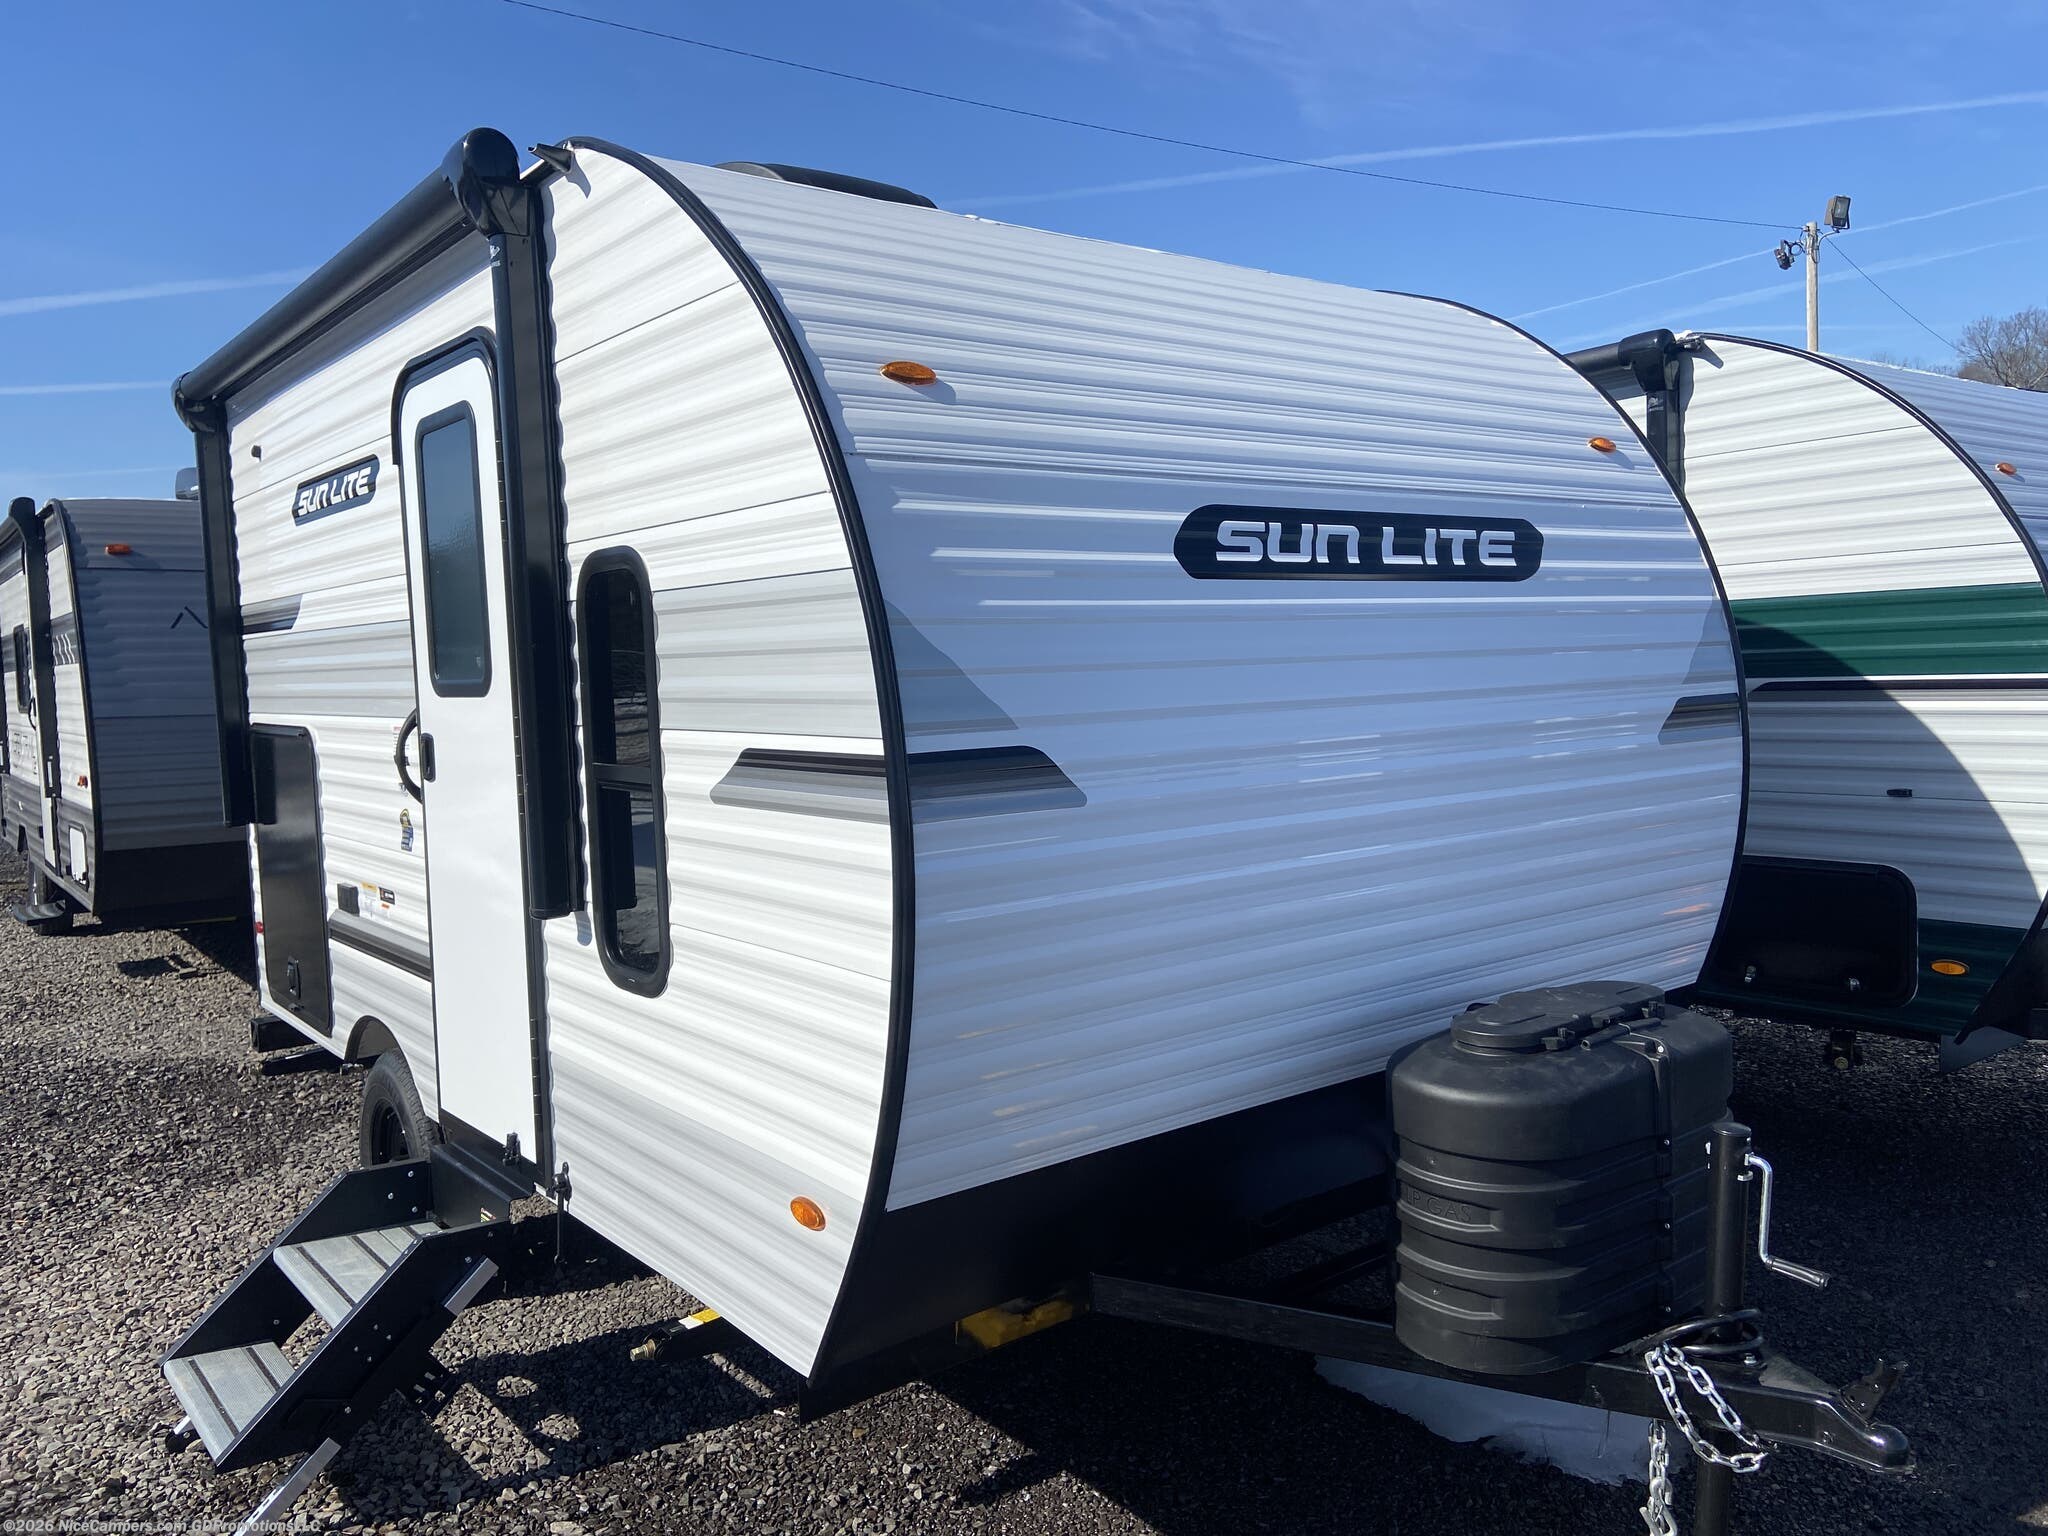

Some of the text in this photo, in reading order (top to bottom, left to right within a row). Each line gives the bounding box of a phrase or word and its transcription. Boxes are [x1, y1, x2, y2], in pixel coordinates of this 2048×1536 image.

[298, 466, 371, 516] SUN LITE
[1215, 520, 1517, 566] SUN LITE
[1427, 1197, 1471, 1222] GAS
